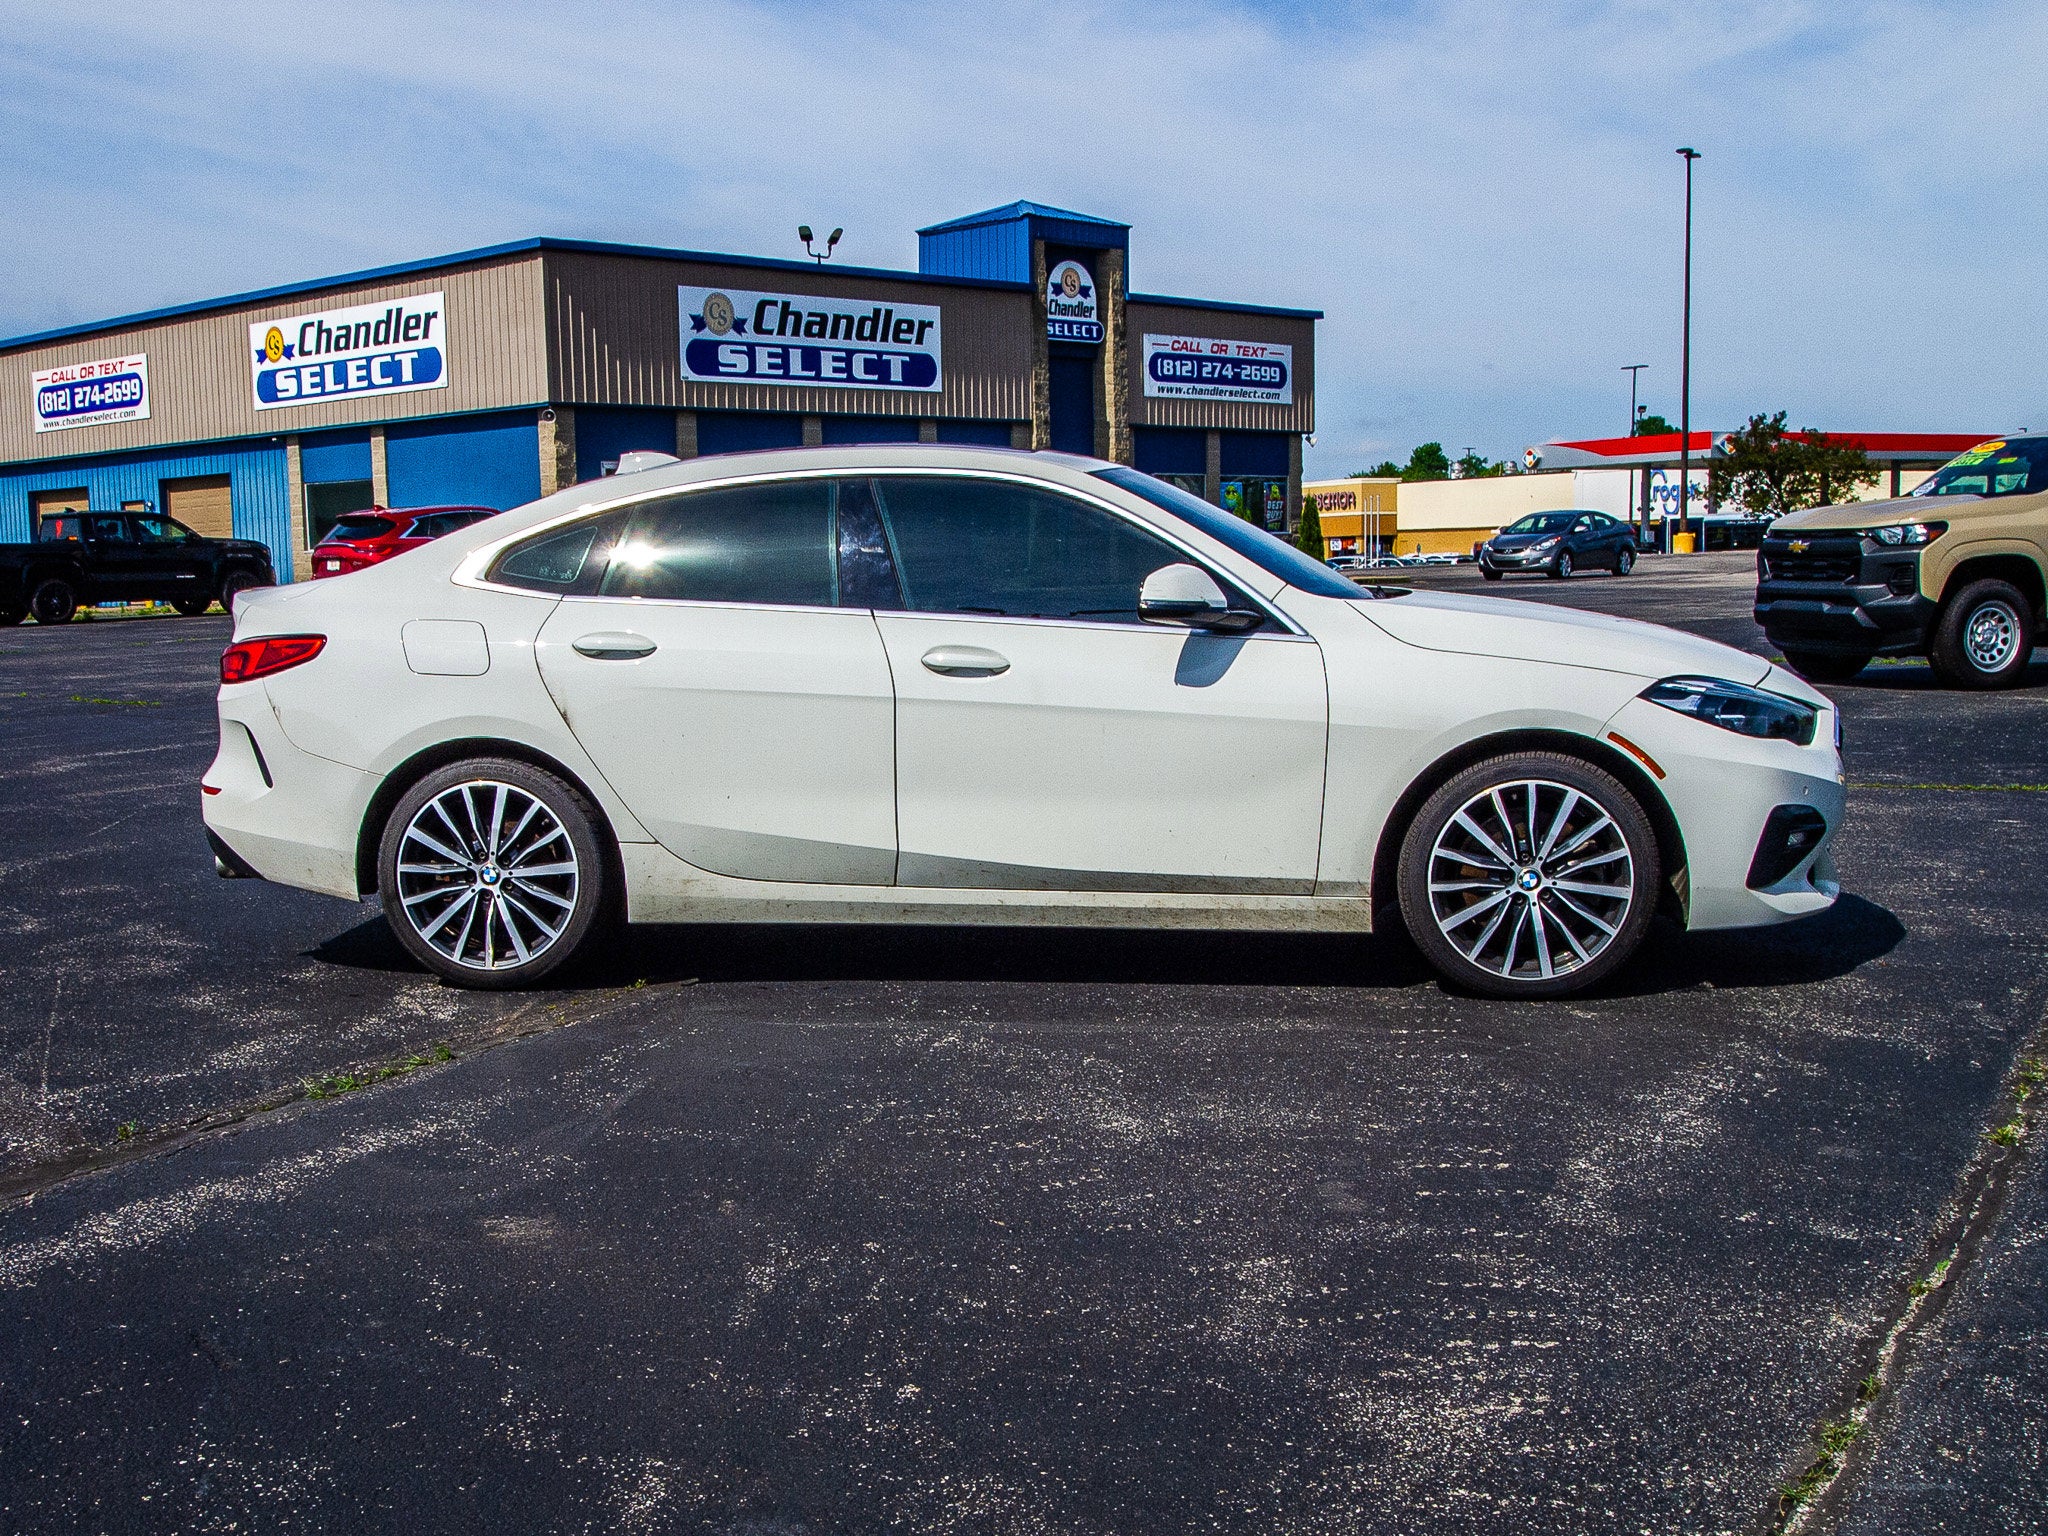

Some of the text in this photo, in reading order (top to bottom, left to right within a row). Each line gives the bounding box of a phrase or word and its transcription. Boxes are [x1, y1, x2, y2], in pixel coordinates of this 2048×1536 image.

[1049, 299, 1095, 318] Chandler
[299, 307, 438, 357] Chandler
[753, 298, 934, 346] Chandler
[1047, 322, 1099, 338] SELECT
[1171, 339, 1268, 358] CALL OR TEXT
[51, 360, 125, 384] CALL OR TEXT
[275, 351, 418, 399] SELECT
[717, 344, 910, 382] SELECT
[1157, 357, 1280, 383] (812) 274-2699
[40, 378, 141, 415] (812) 274-2699
[1157, 384, 1281, 401] www.chandlerselect.com
[43, 409, 136, 429] www.chandlerselect.com
[1650, 469, 1699, 515] rogr
[1267, 500, 1284, 510] BEST
